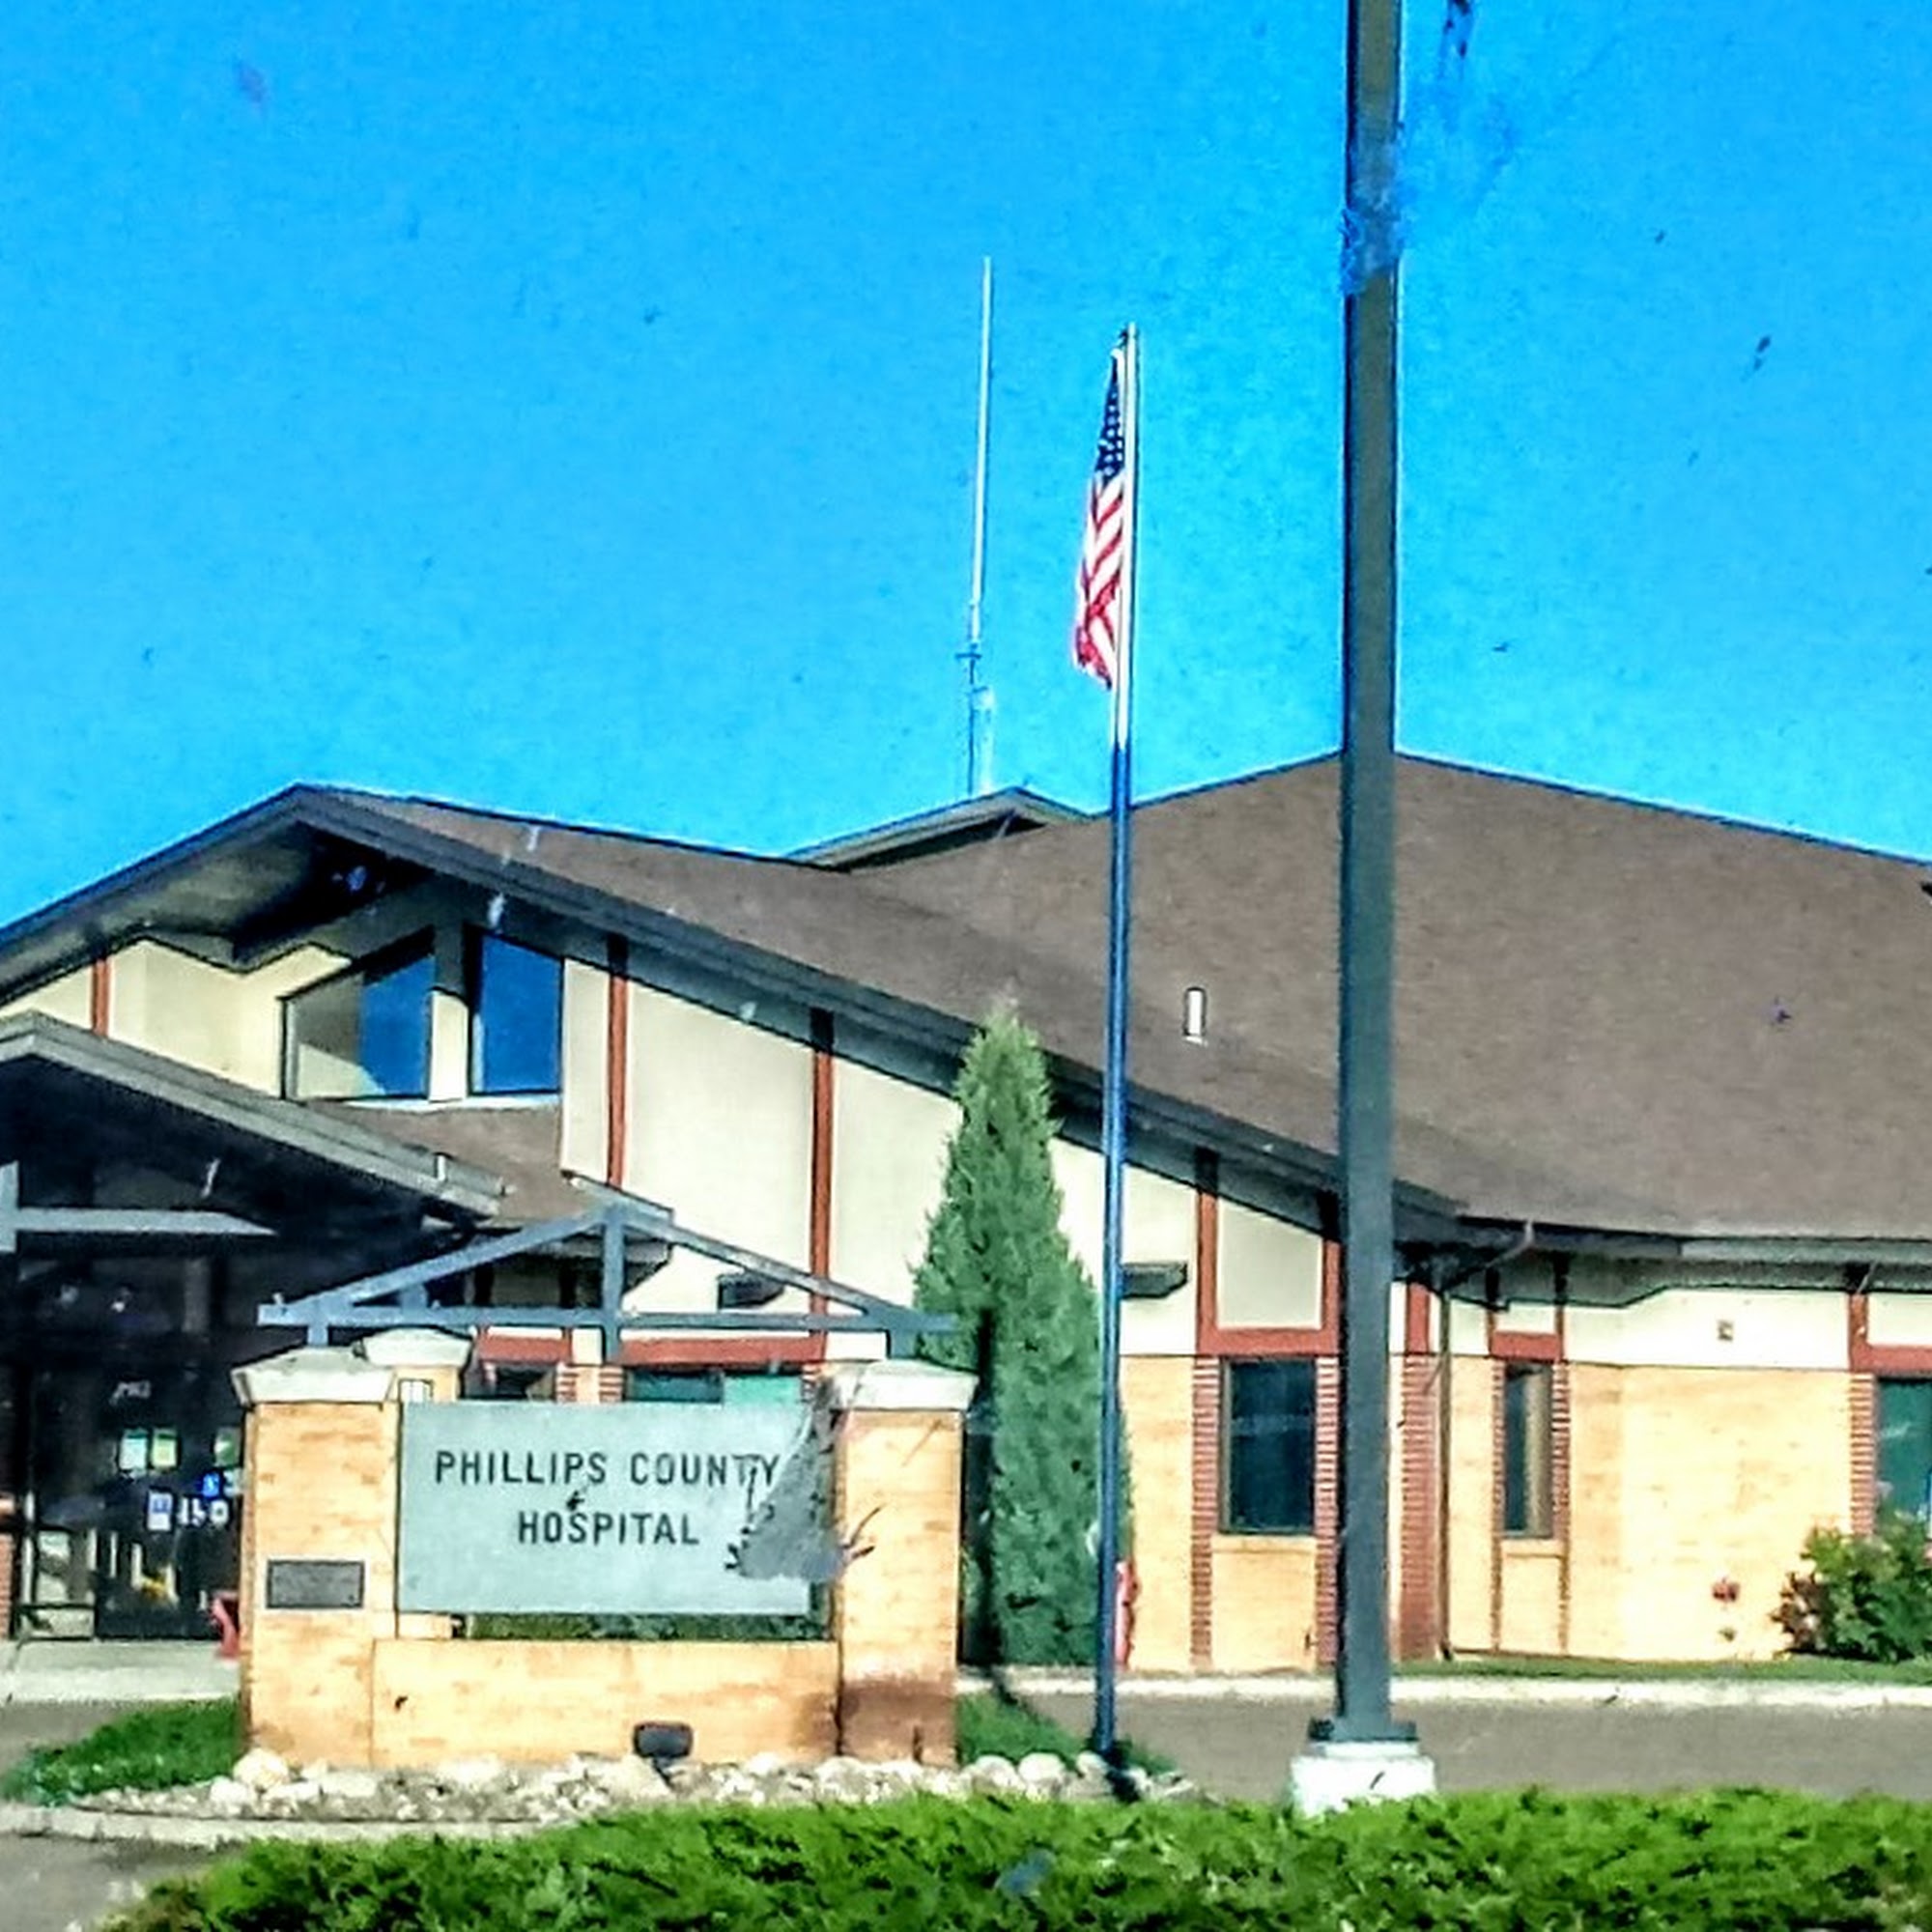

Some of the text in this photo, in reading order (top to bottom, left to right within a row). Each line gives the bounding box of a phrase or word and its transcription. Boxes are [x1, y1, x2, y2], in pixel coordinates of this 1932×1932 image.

[436, 1452, 780, 1486] PHILLIPS COUNTY
[518, 1511, 699, 1546] HOSPITAL
